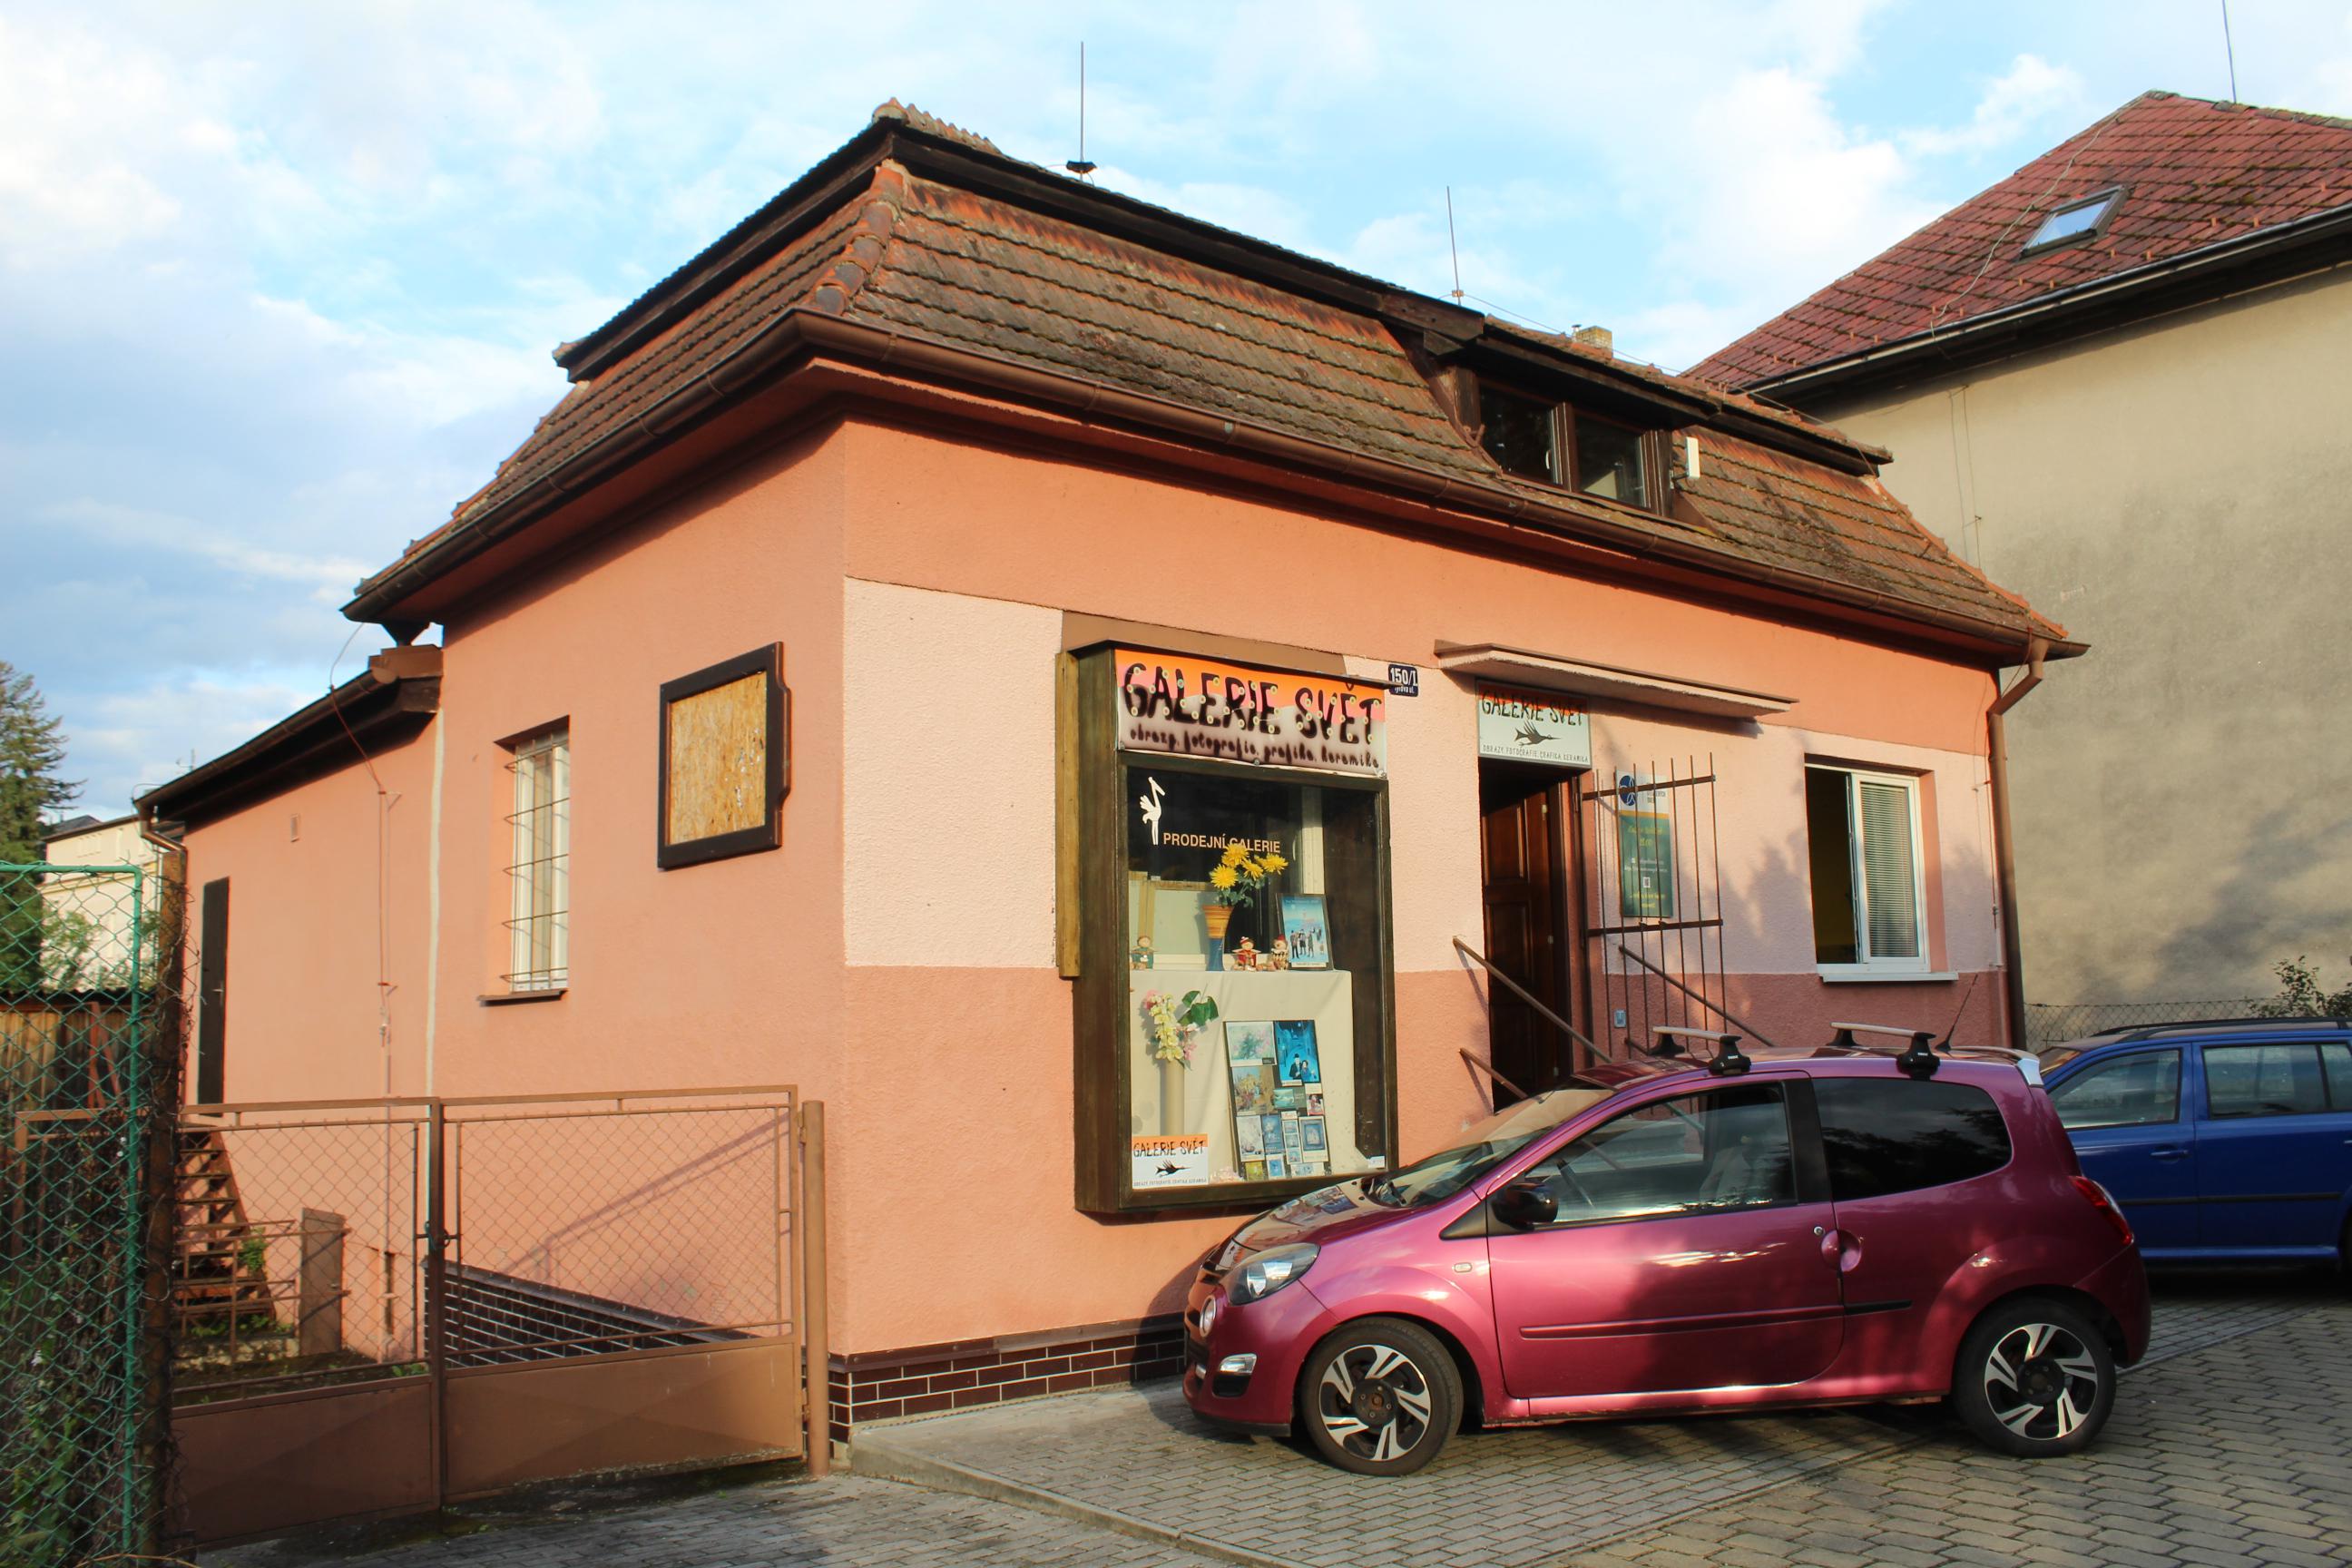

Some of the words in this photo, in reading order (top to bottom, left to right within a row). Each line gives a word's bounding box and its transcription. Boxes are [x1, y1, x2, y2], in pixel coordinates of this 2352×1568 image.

[1123, 662, 1281, 735] GALERIE
[1295, 681, 1382, 745] SVĚT
[1482, 691, 1544, 721] GALERIE
[1162, 832, 1226, 849] PRODEJNÍ
[1133, 1141, 1177, 1157] GALERIE
